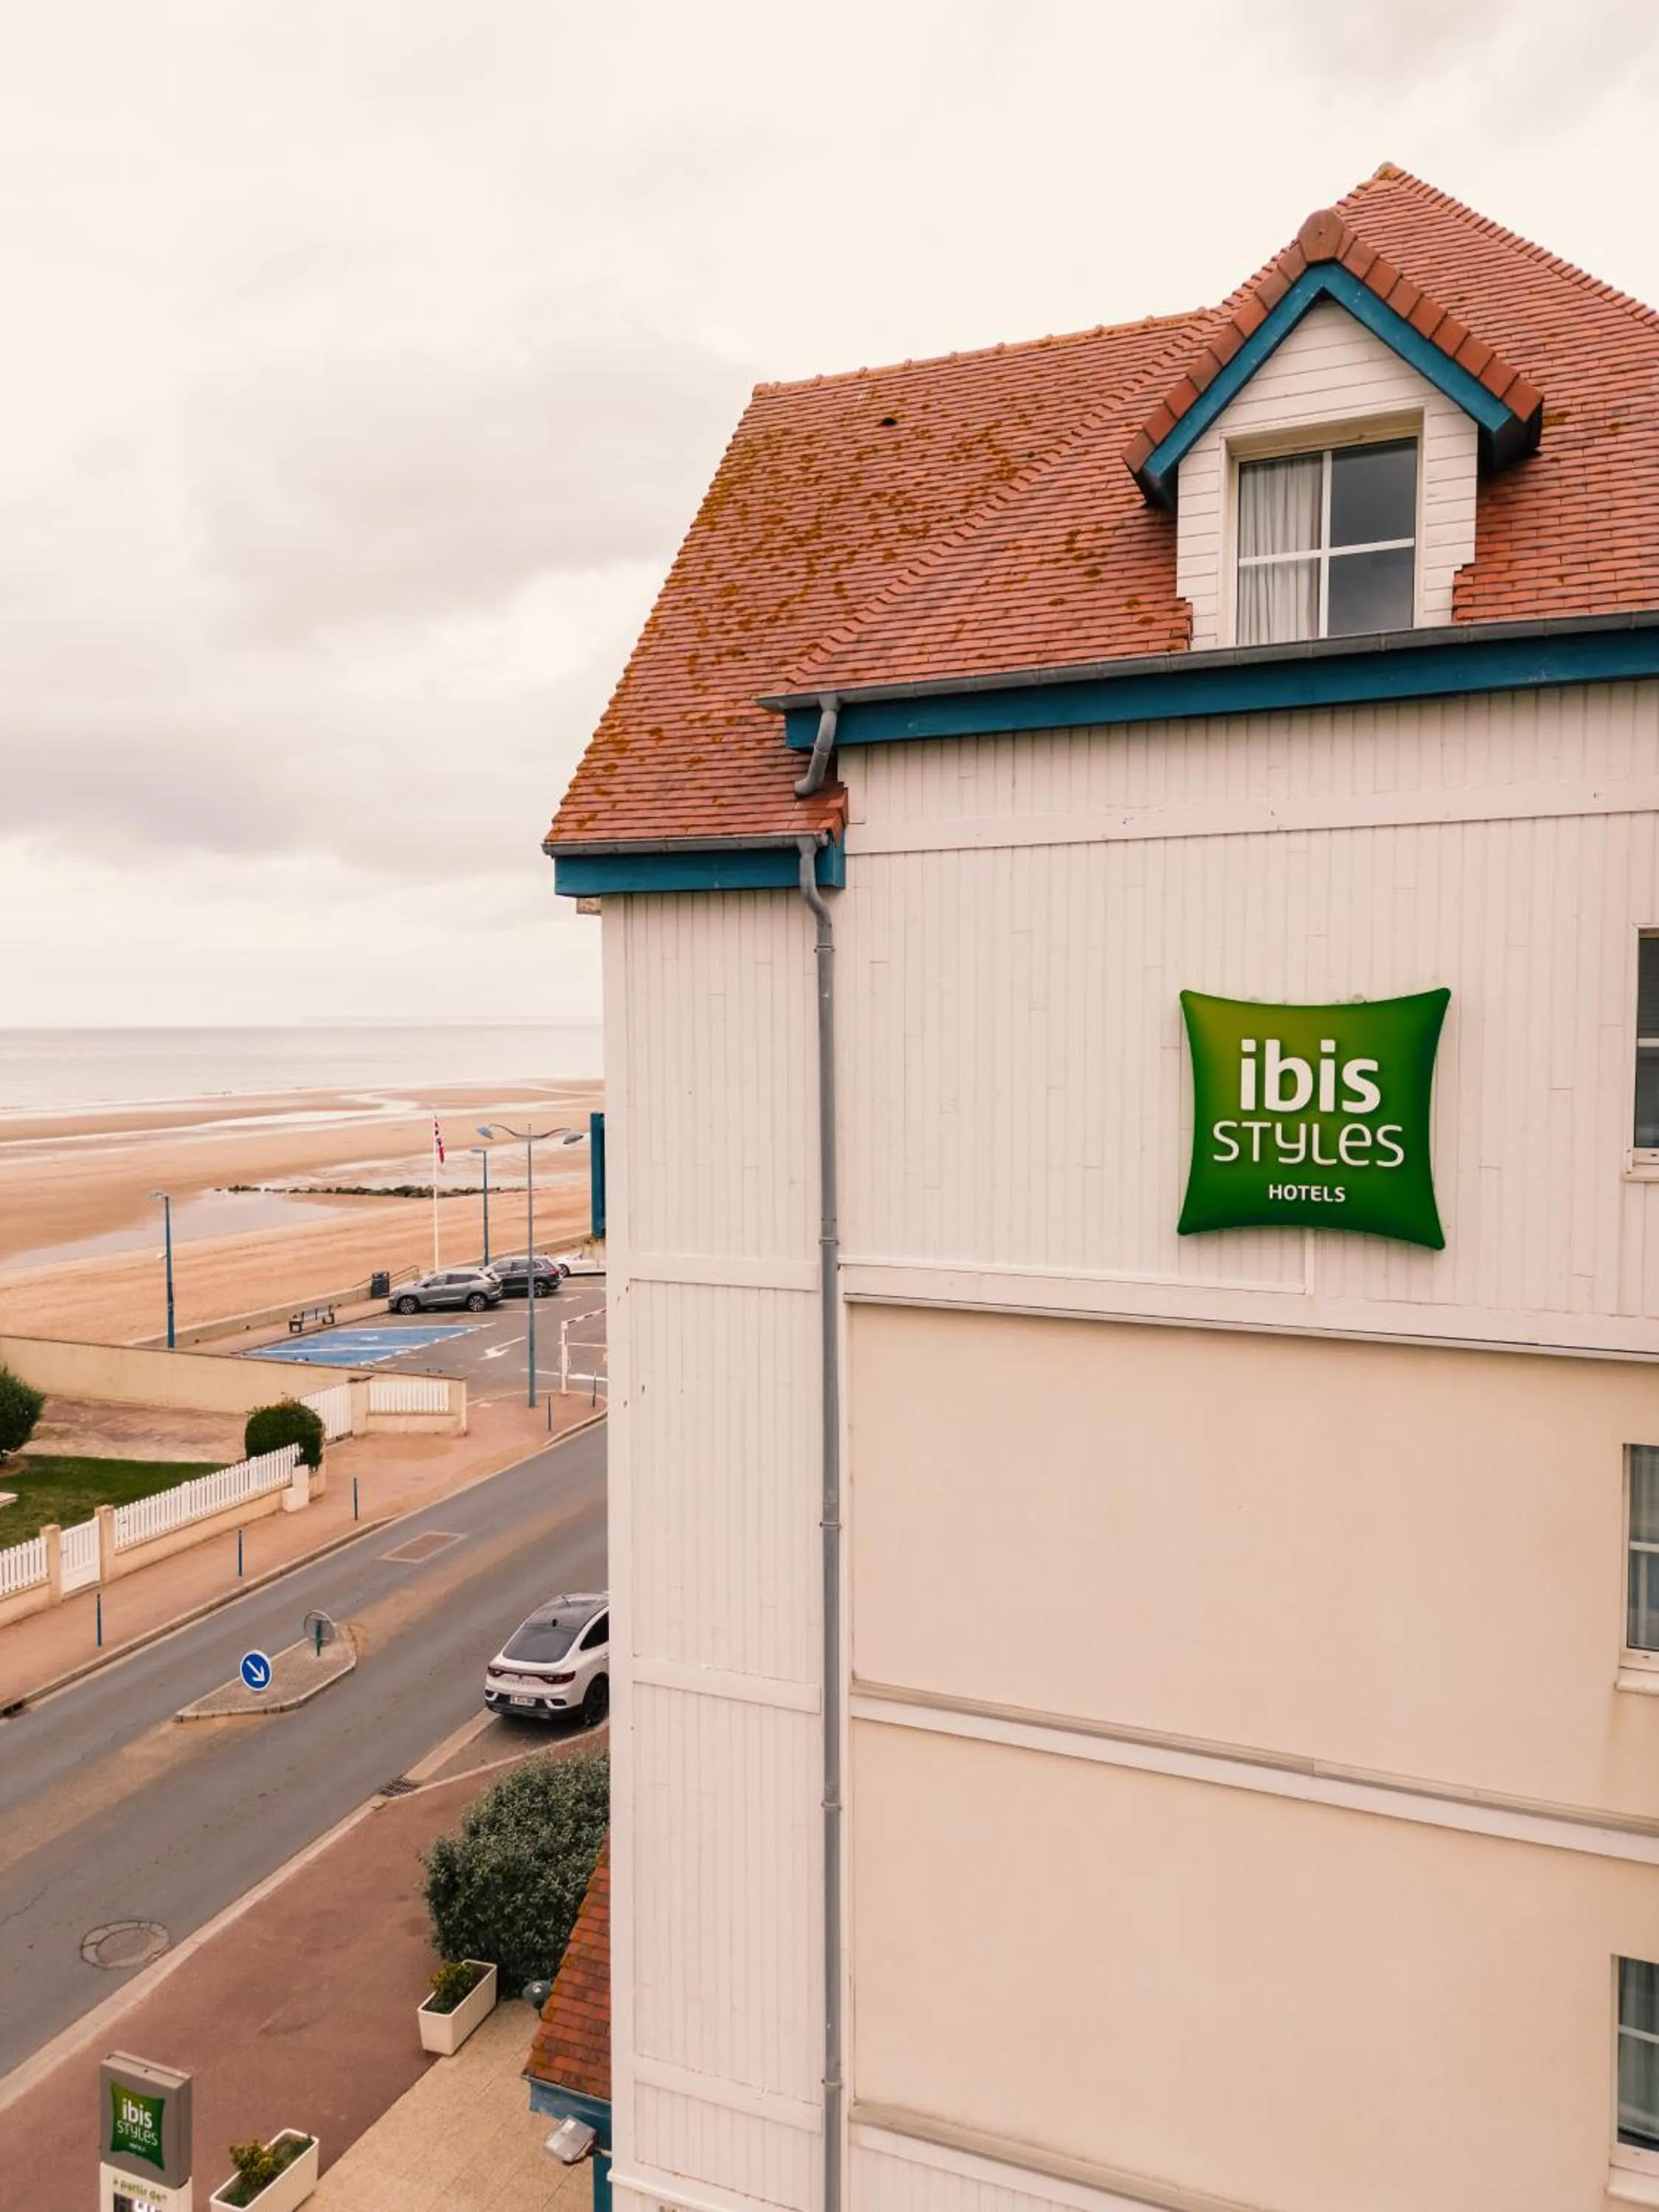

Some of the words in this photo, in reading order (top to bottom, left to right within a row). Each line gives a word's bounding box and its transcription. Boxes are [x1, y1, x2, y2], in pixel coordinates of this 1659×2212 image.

[1239, 1038, 1381, 1113] ibis
[1268, 1183, 1346, 1203] HOTELS
[122, 2097, 153, 2129] ibis
